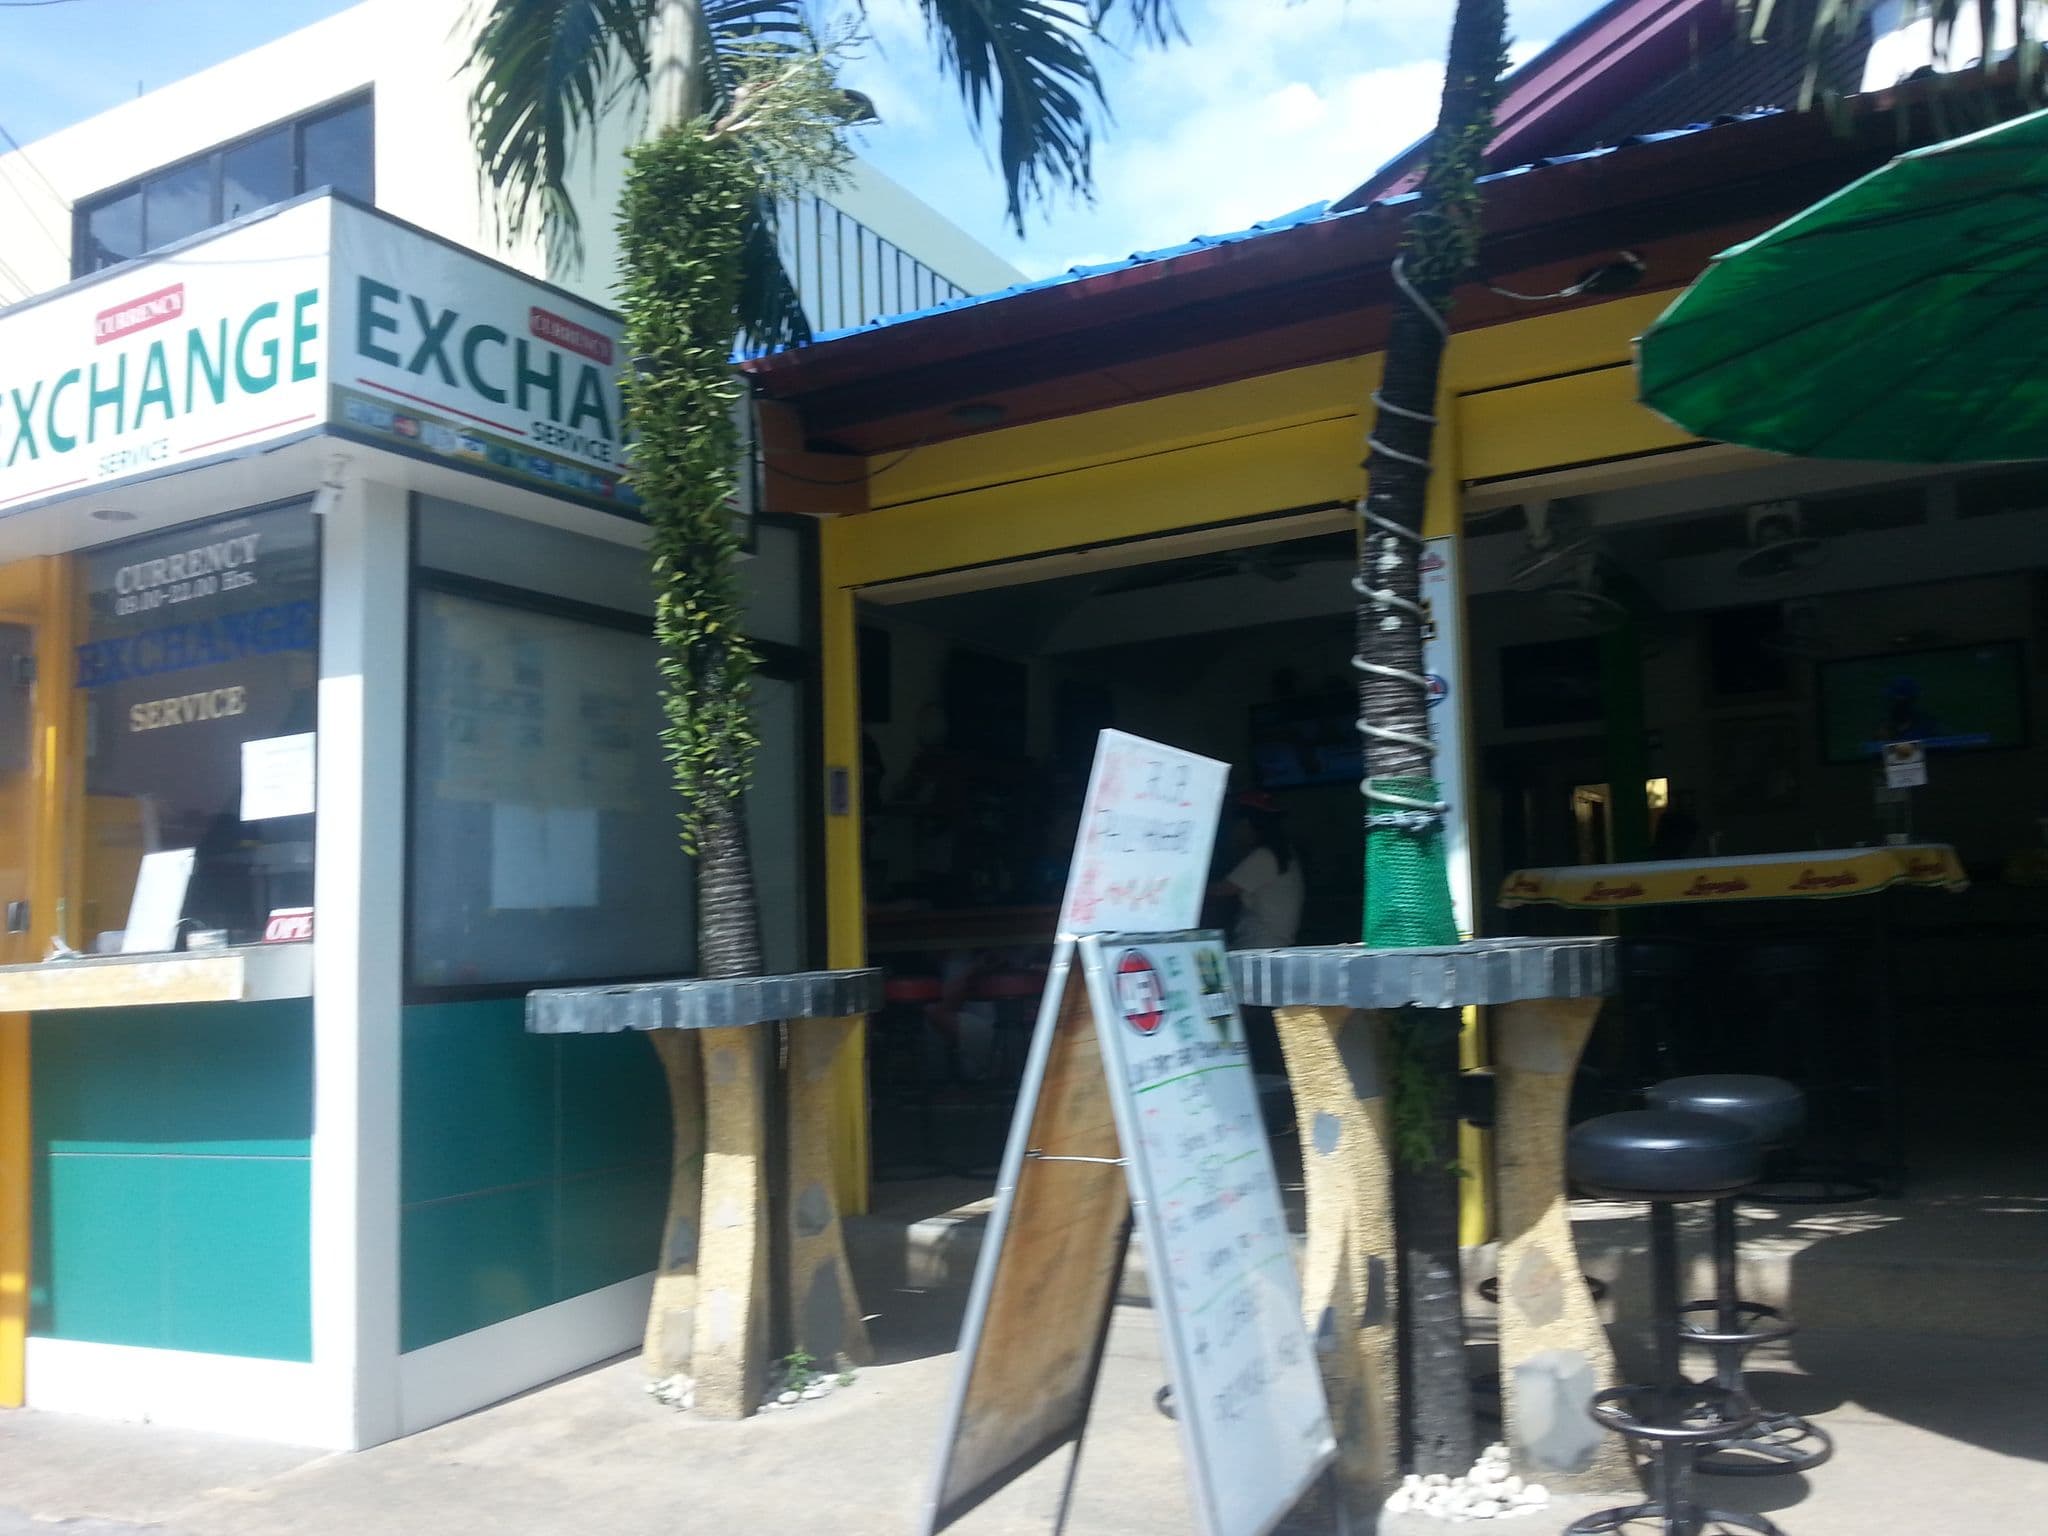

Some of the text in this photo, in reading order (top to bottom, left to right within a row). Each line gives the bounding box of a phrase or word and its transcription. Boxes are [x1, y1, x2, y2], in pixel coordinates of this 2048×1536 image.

[0, 287, 319, 467] XCHANGE
[97, 437, 170, 477] SERVICE
[530, 421, 612, 463] SERVICE
[114, 533, 262, 595] CURRENCY
[129, 685, 247, 732] SERVICE
